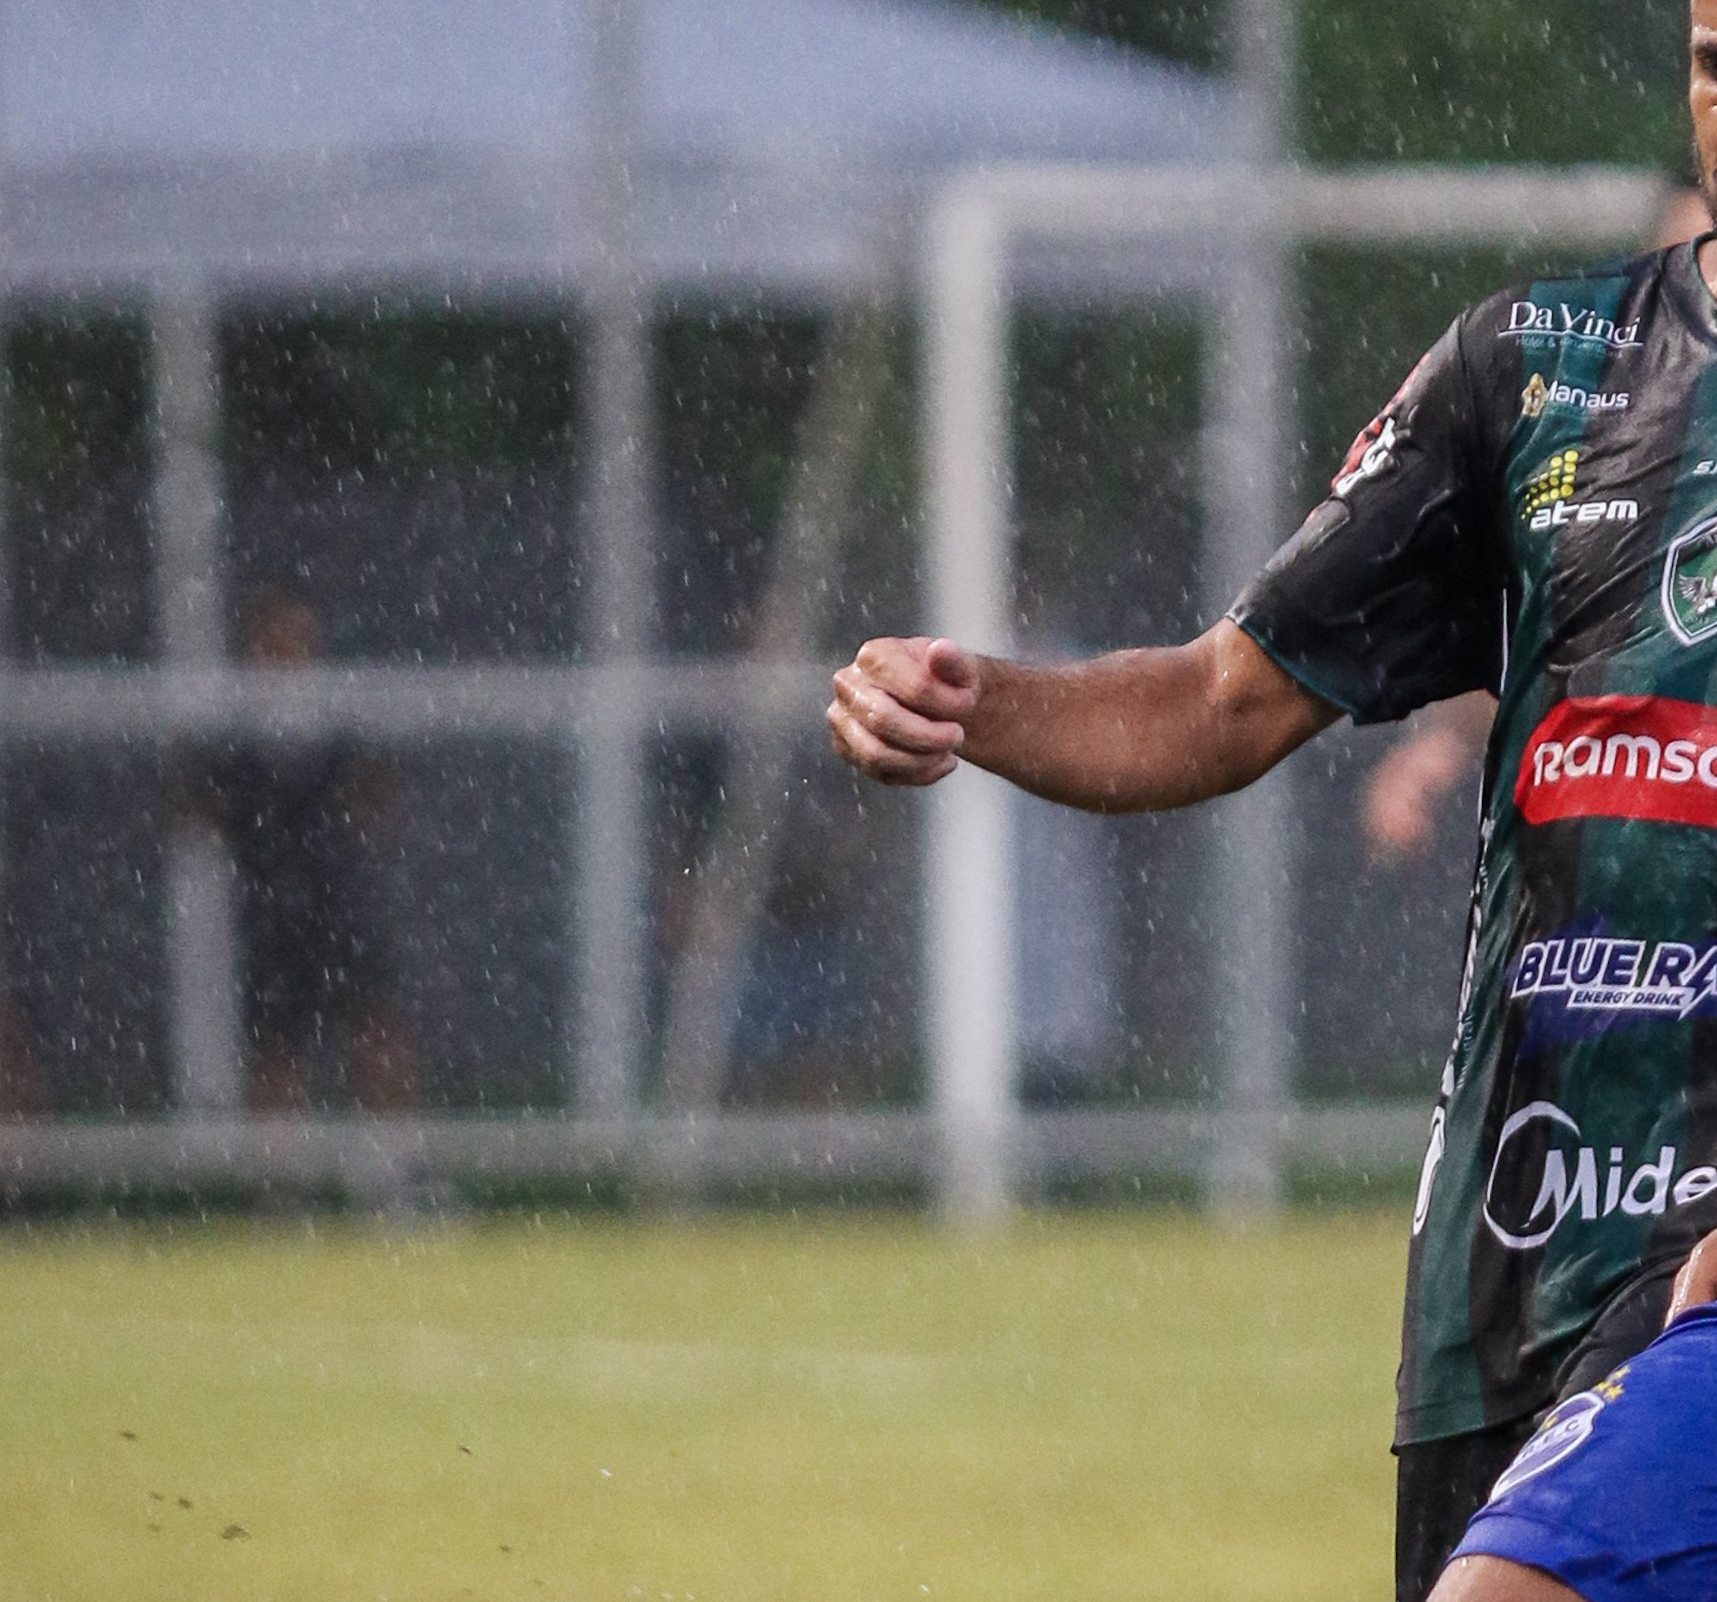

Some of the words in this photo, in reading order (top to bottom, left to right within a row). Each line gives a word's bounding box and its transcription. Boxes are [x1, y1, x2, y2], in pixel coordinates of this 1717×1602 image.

[1508, 301, 1553, 330] Da
[1560, 302, 1641, 344] Vinci
[1529, 499, 1639, 530] atem
[1511, 937, 1647, 998] BLUE
[1573, 990, 1630, 1004] ENERGY
[1632, 992, 1685, 1006] DRINK
